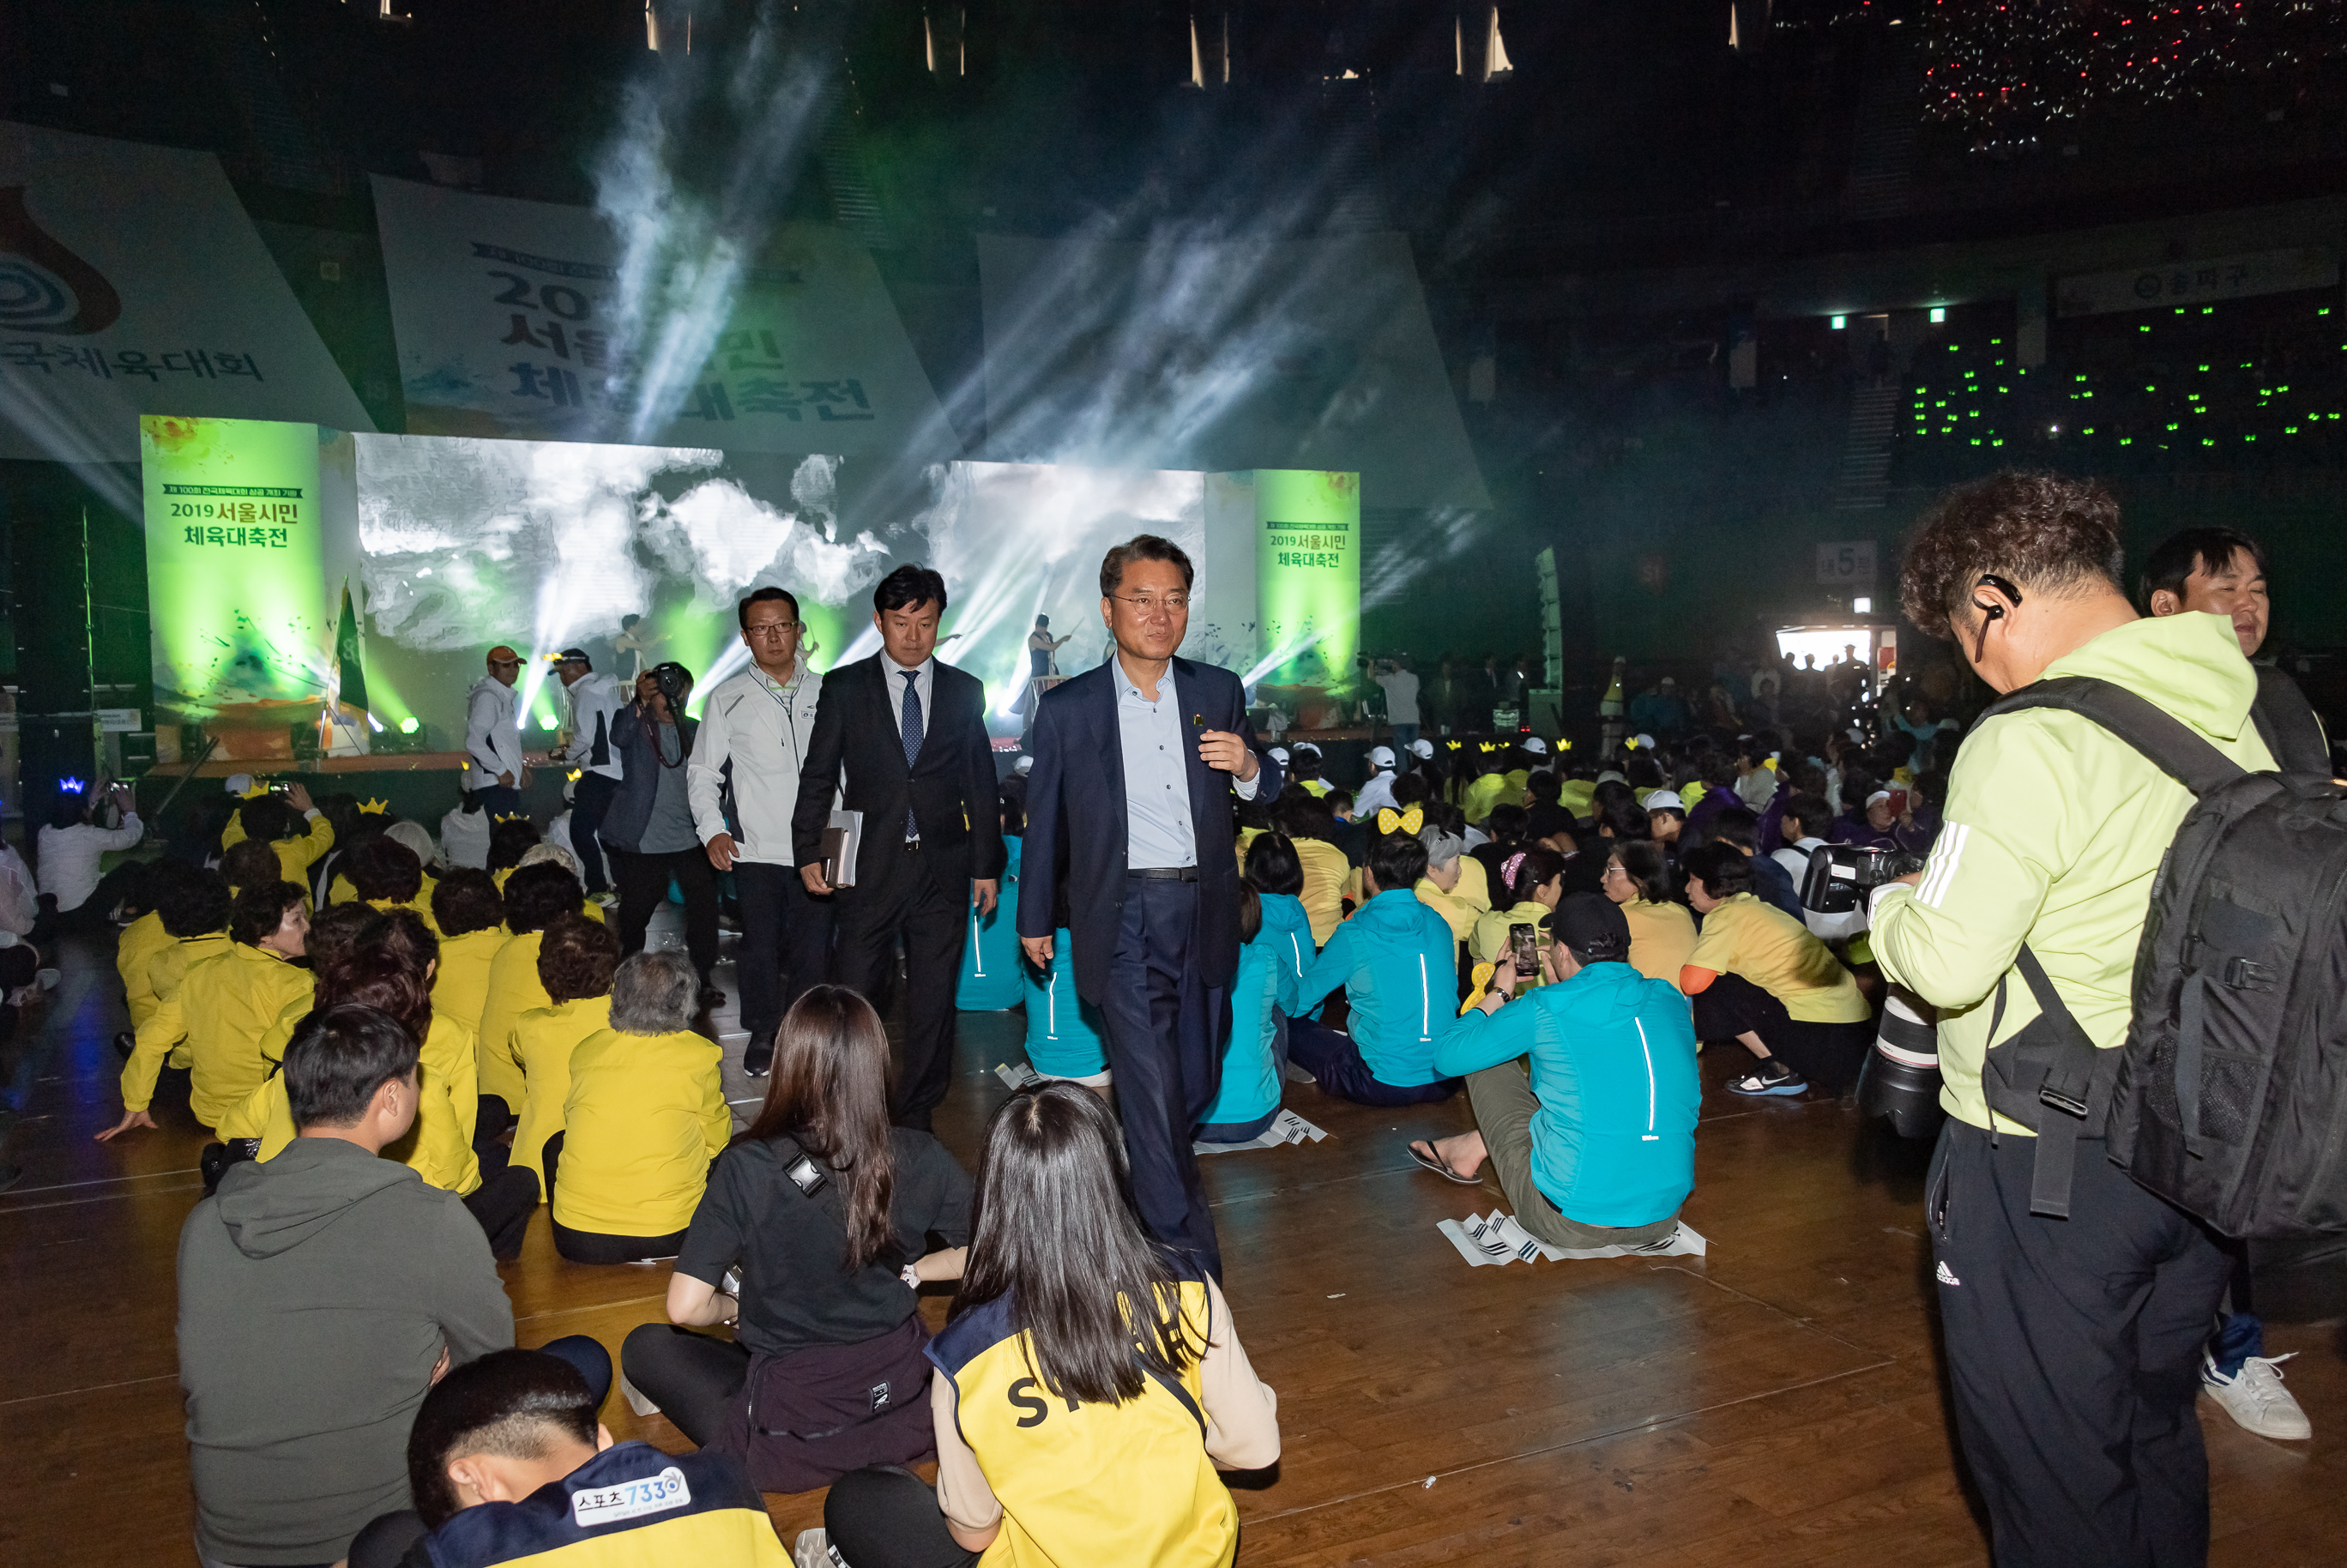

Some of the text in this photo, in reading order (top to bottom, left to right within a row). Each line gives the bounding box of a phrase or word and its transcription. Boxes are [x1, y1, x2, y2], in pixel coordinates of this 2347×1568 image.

[0, 340, 264, 383] 국체육대회
[171, 502, 298, 524] 2019 서울시민
[184, 525, 288, 548] 체육대축전
[1270, 534, 1346, 550] 2019 서울시민
[1277, 552, 1339, 568] 체육대축전
